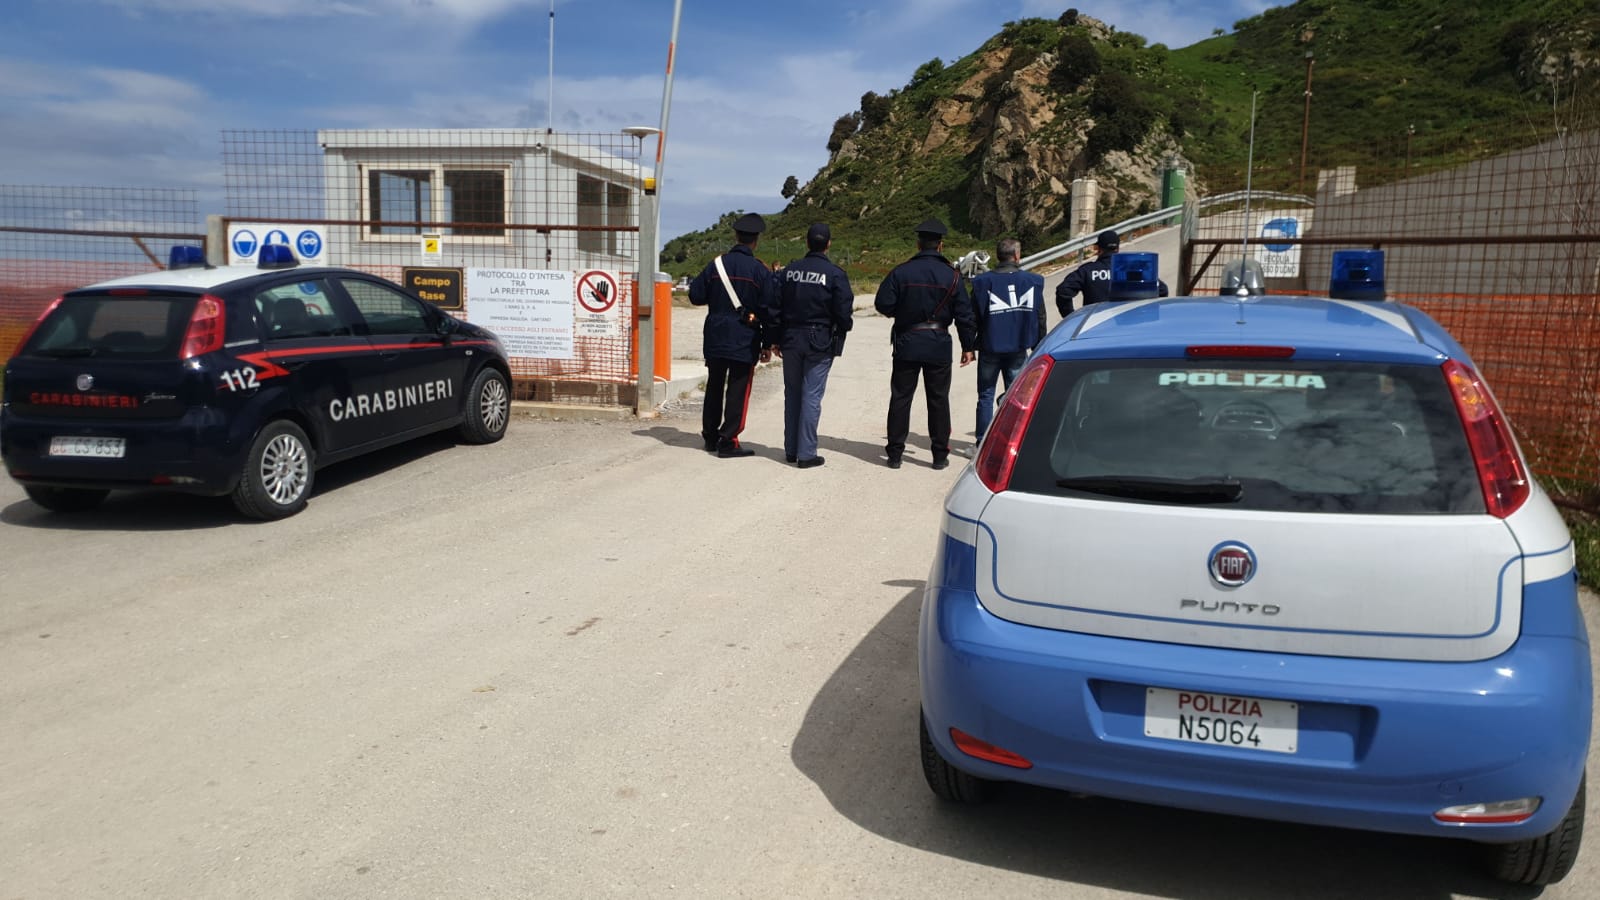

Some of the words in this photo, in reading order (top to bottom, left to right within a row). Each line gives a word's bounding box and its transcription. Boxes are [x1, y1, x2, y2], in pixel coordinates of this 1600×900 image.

[413, 276, 452, 288] Campo
[476, 270, 527, 280] PROTOCOLLO
[529, 272, 566, 281] D'INTESA
[786, 270, 827, 286] POLIZIA
[418, 290, 446, 301] Base
[490, 287, 500, 295] LA
[501, 287, 550, 296] PREFETTURA
[220, 366, 261, 392] 112
[1158, 372, 1327, 389] POLIZIA
[31, 392, 139, 408] CARABINIERI
[329, 377, 454, 422] CARABINIERI
[1220, 556, 1246, 575] FIAT
[1180, 599, 1281, 616] PUNTO
[1178, 693, 1263, 718] POLIZIA
[1178, 714, 1261, 747] N5064
